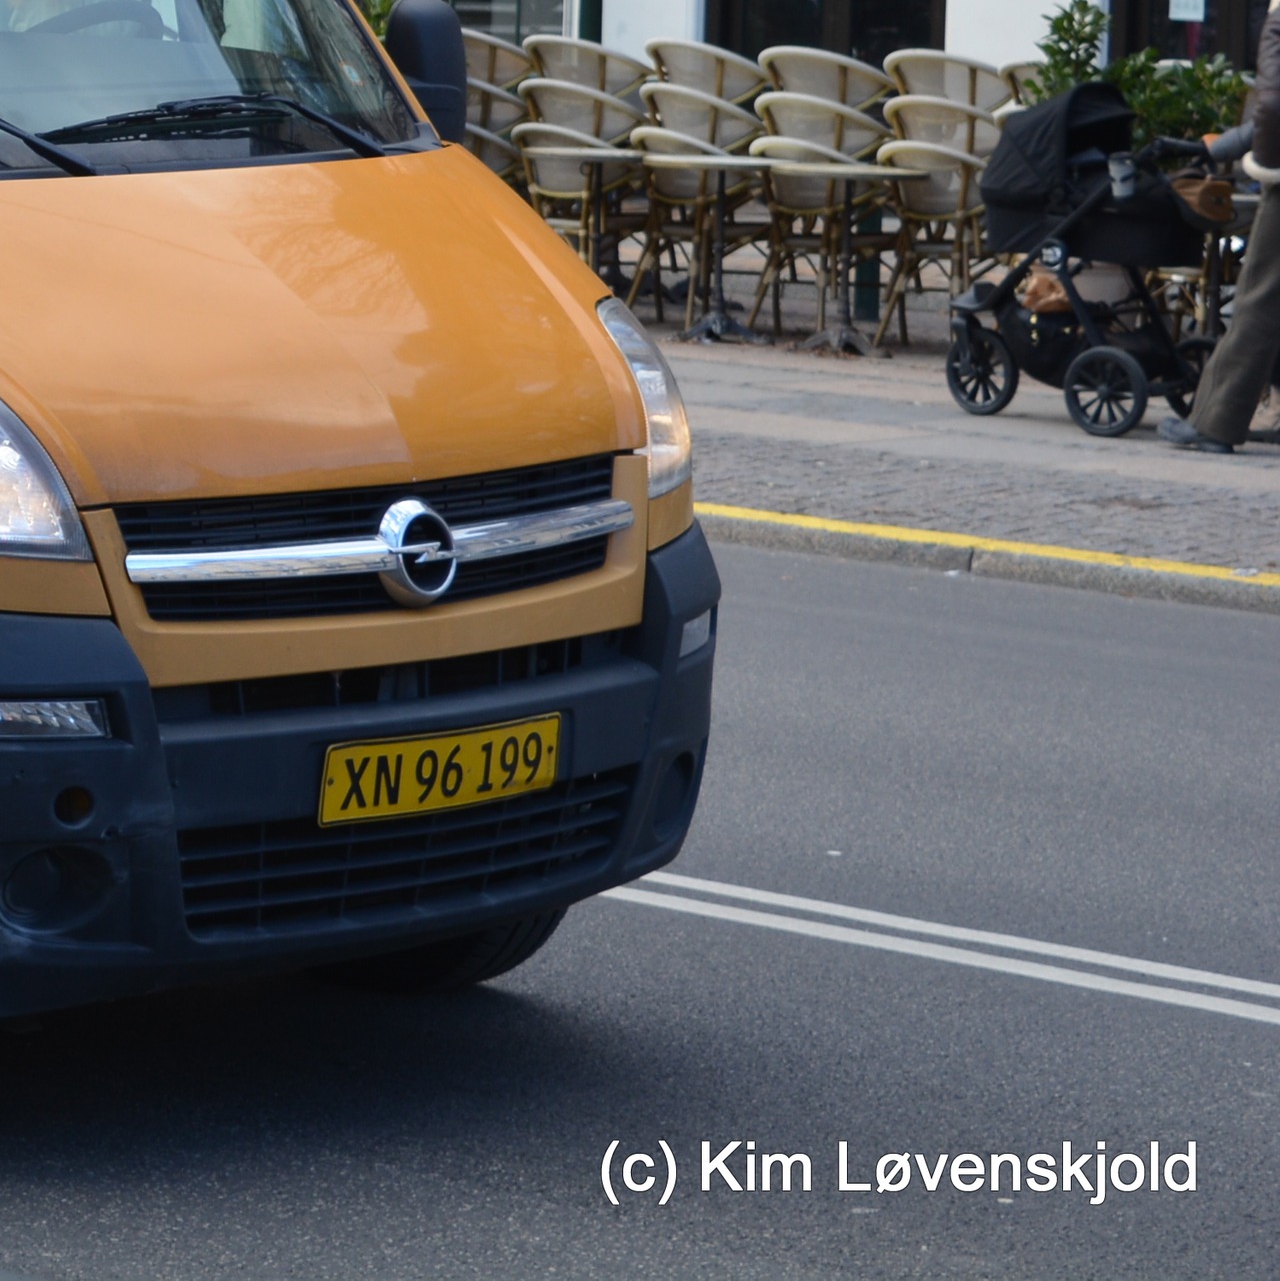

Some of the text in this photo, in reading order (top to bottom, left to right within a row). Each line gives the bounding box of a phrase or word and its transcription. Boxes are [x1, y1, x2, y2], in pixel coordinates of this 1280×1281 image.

[340, 731, 543, 811] XN 96 199
